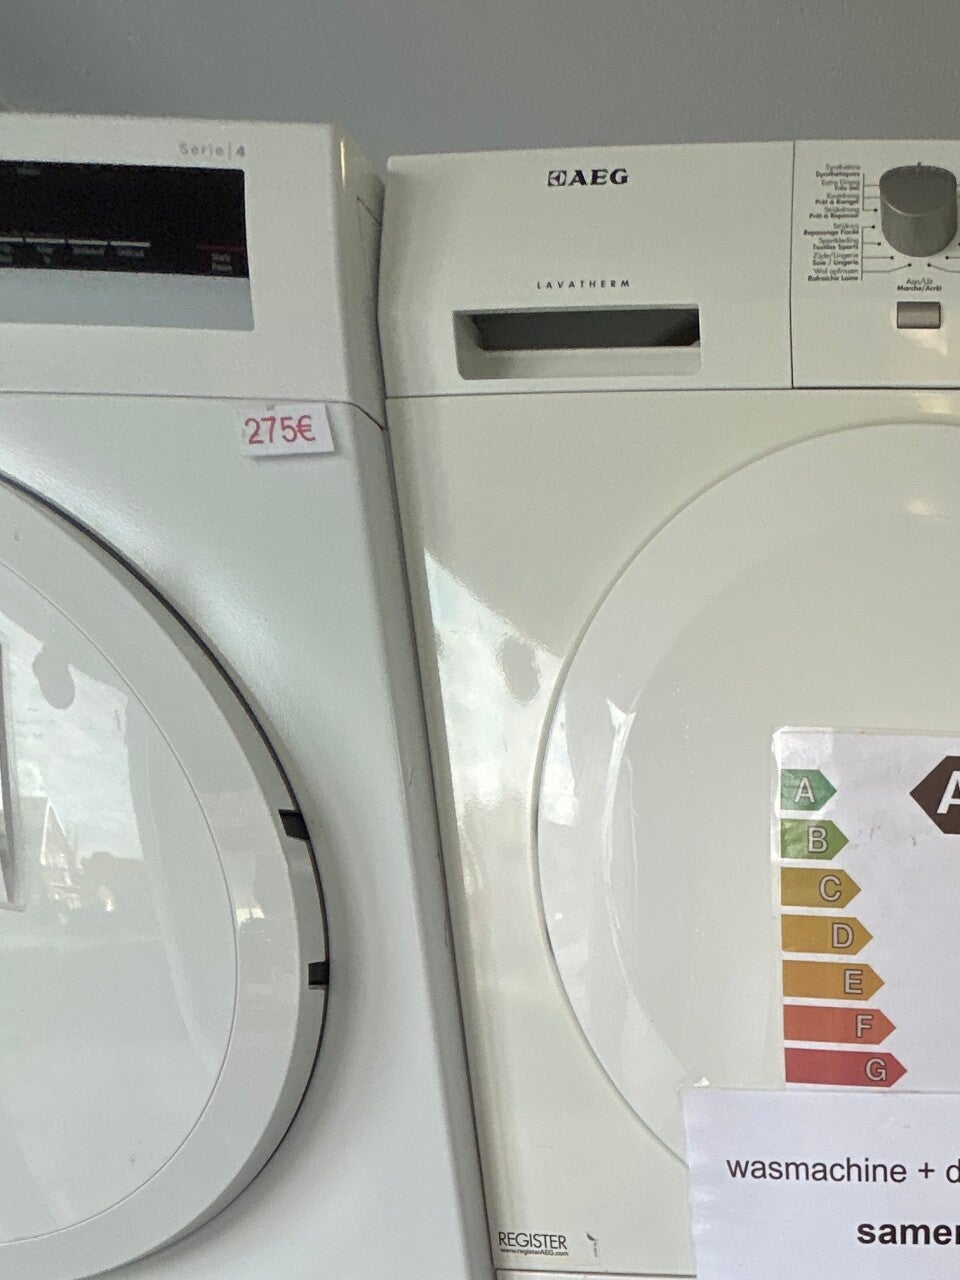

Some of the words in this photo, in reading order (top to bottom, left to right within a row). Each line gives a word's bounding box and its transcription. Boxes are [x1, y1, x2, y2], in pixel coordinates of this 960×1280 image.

[567, 167, 629, 187] AEG
[537, 279, 630, 290] LAVATHERM
[244, 415, 316, 445] 275€
[794, 777, 815, 803] A
[807, 826, 829, 853] B
[818, 875, 842, 902] C
[831, 922, 855, 948] D
[843, 969, 863, 995] E
[855, 1014, 873, 1037] F
[865, 1059, 888, 1081] G
[726, 1157, 907, 1183] wasmachine
[918, 1164, 936, 1179] +
[498, 1231, 567, 1250] REGISTER
